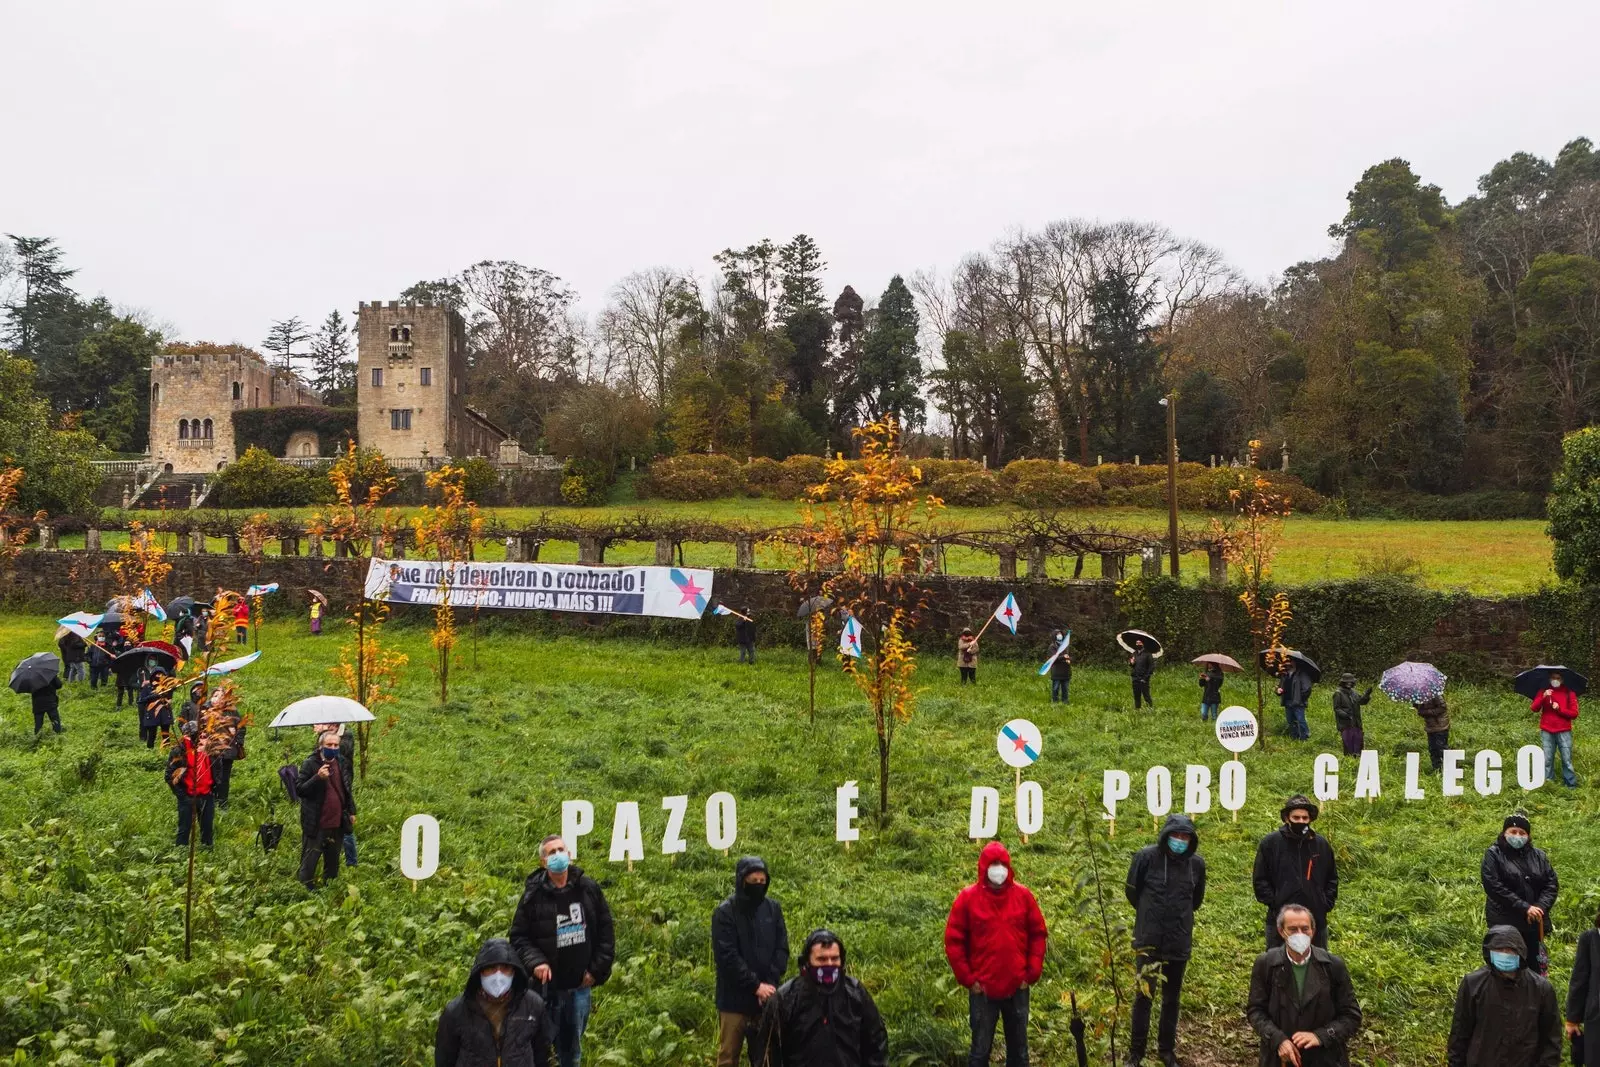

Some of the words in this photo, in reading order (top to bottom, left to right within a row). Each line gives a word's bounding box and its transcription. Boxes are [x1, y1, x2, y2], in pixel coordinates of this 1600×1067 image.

[425, 567, 454, 585] nos
[460, 566, 537, 588] devolvan
[542, 571, 552, 583] o
[557, 570, 635, 592] roubado
[640, 570, 646, 592] !
[505, 591, 554, 609] NUNCA
[556, 592, 595, 612] MÁIS
[598, 596, 614, 612] !!!
[1220, 723, 1254, 732] FRANQUISMO
[1220, 730, 1240, 739] NUNCA
[400, 814, 441, 880] O
[562, 791, 738, 862] PAZO
[836, 780, 859, 842] É
[969, 781, 1044, 839] DO
[1103, 760, 1247, 820] POBO
[1313, 744, 1546, 801] GALEGO
